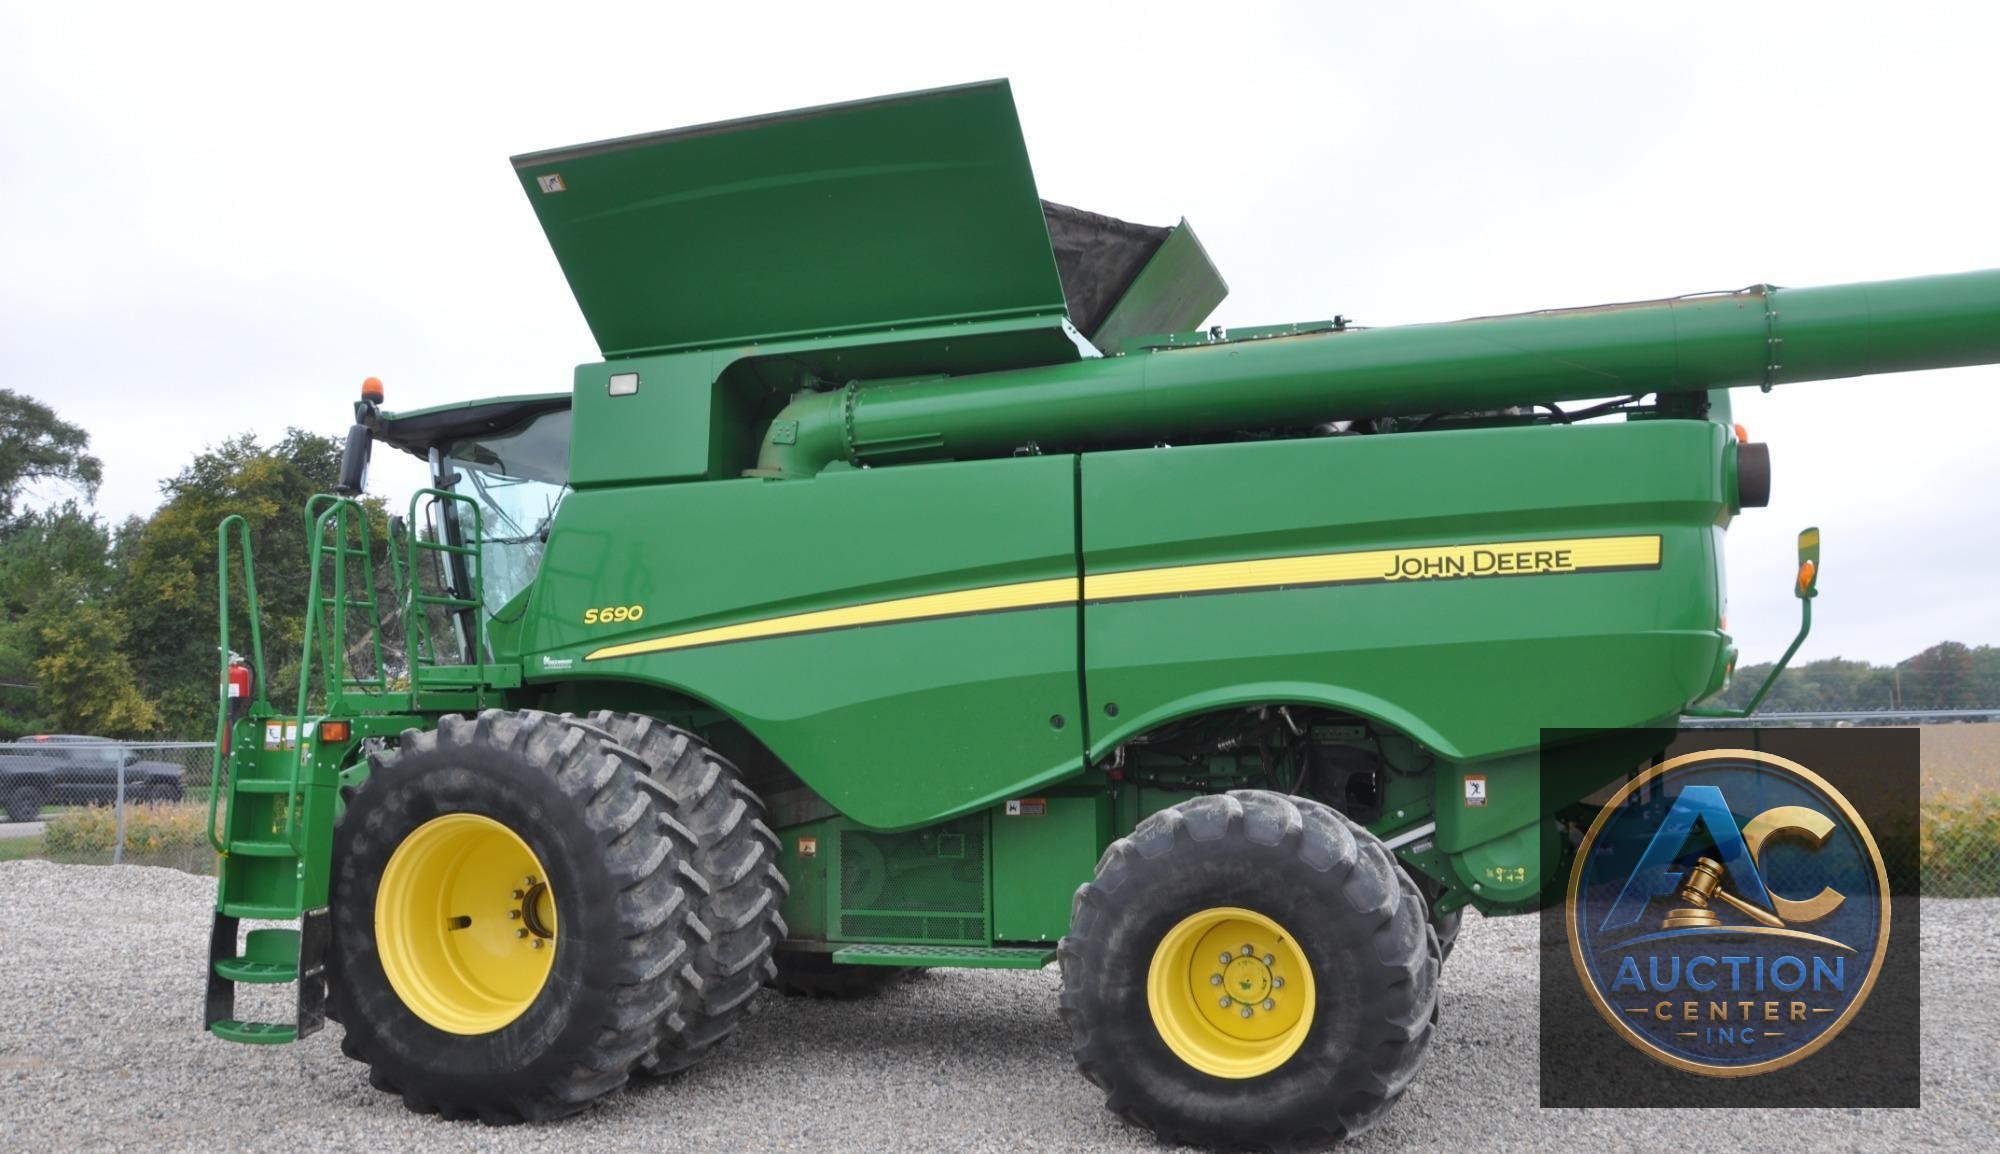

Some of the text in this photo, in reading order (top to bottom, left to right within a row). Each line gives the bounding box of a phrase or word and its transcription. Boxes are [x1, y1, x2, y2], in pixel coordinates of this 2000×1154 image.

[1384, 549, 1573, 577] JOHN DEERE
[584, 605, 643, 625] S690
